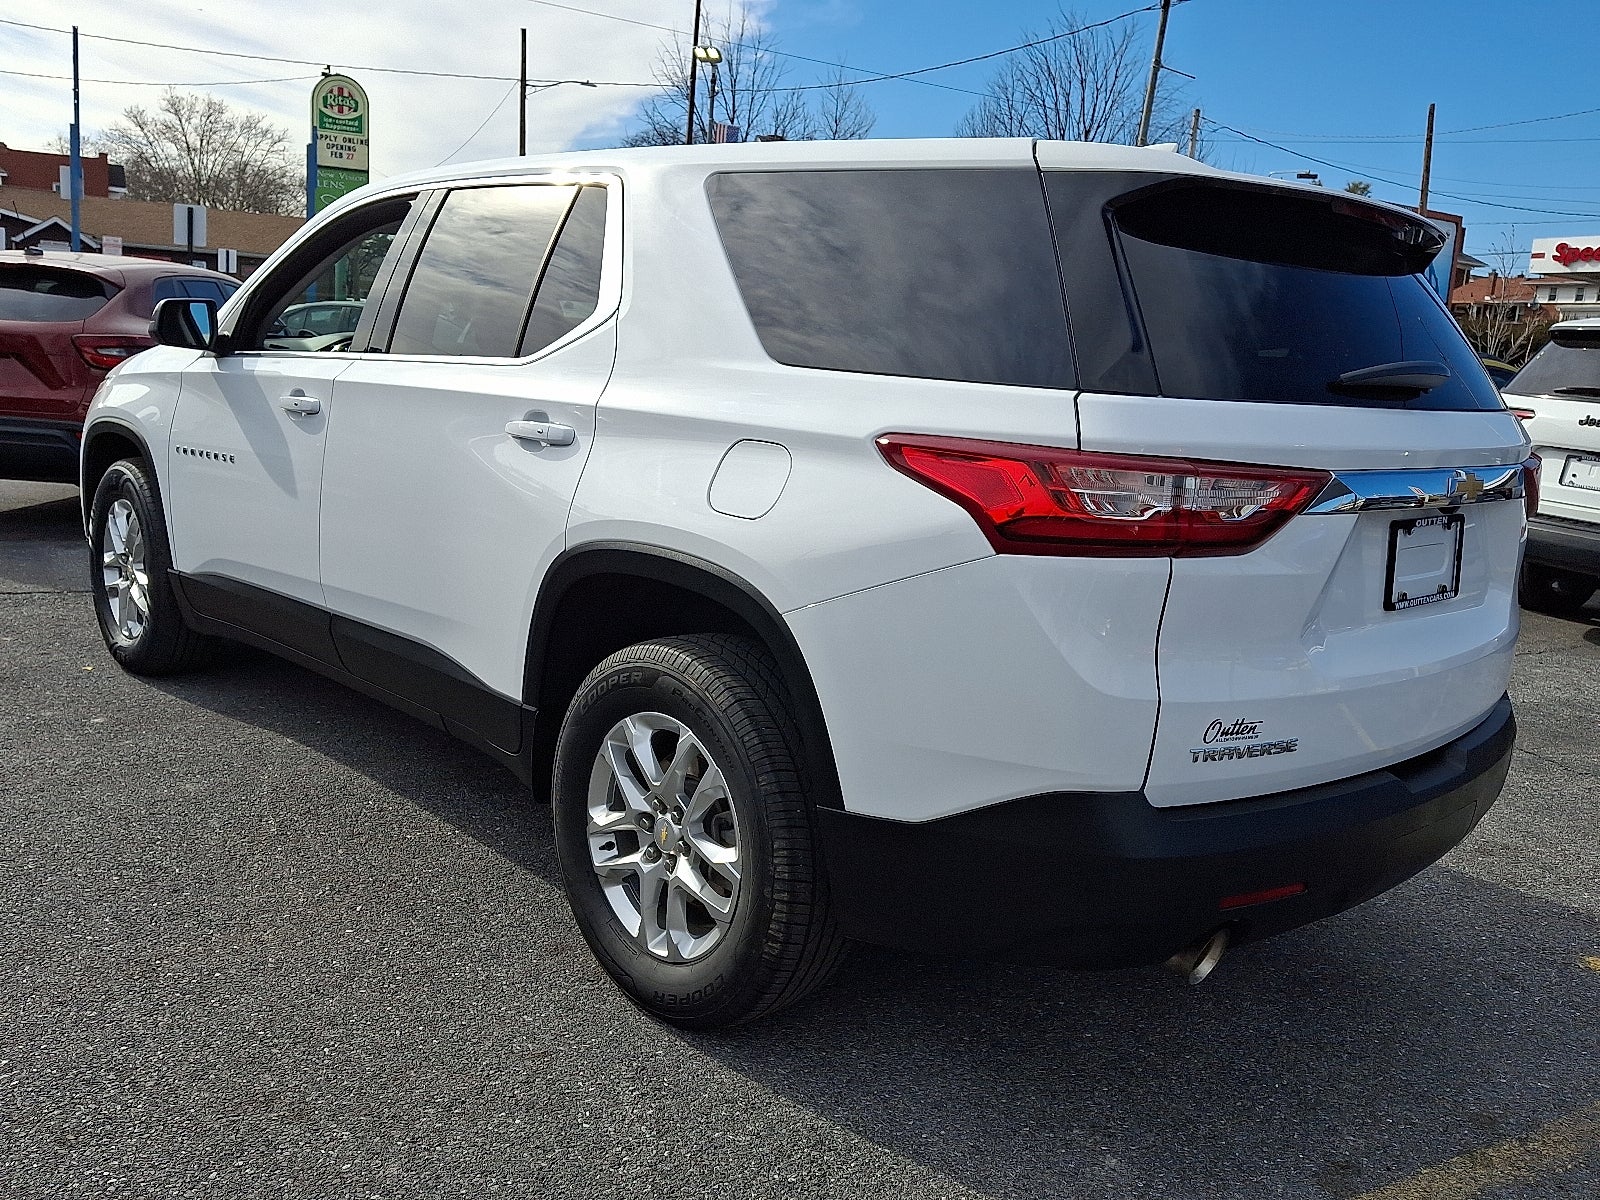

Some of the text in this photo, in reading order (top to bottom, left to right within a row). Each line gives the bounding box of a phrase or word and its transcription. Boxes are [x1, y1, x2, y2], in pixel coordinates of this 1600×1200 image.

[327, 92, 356, 108] Rita's
[326, 143, 356, 152] OPENING
[330, 151, 343, 159] FEB
[1416, 516, 1448, 527] OUTTEN
[580, 671, 643, 714] COOPER
[1203, 718, 1263, 744] Outten
[1190, 738, 1299, 763] TRAVERSE
